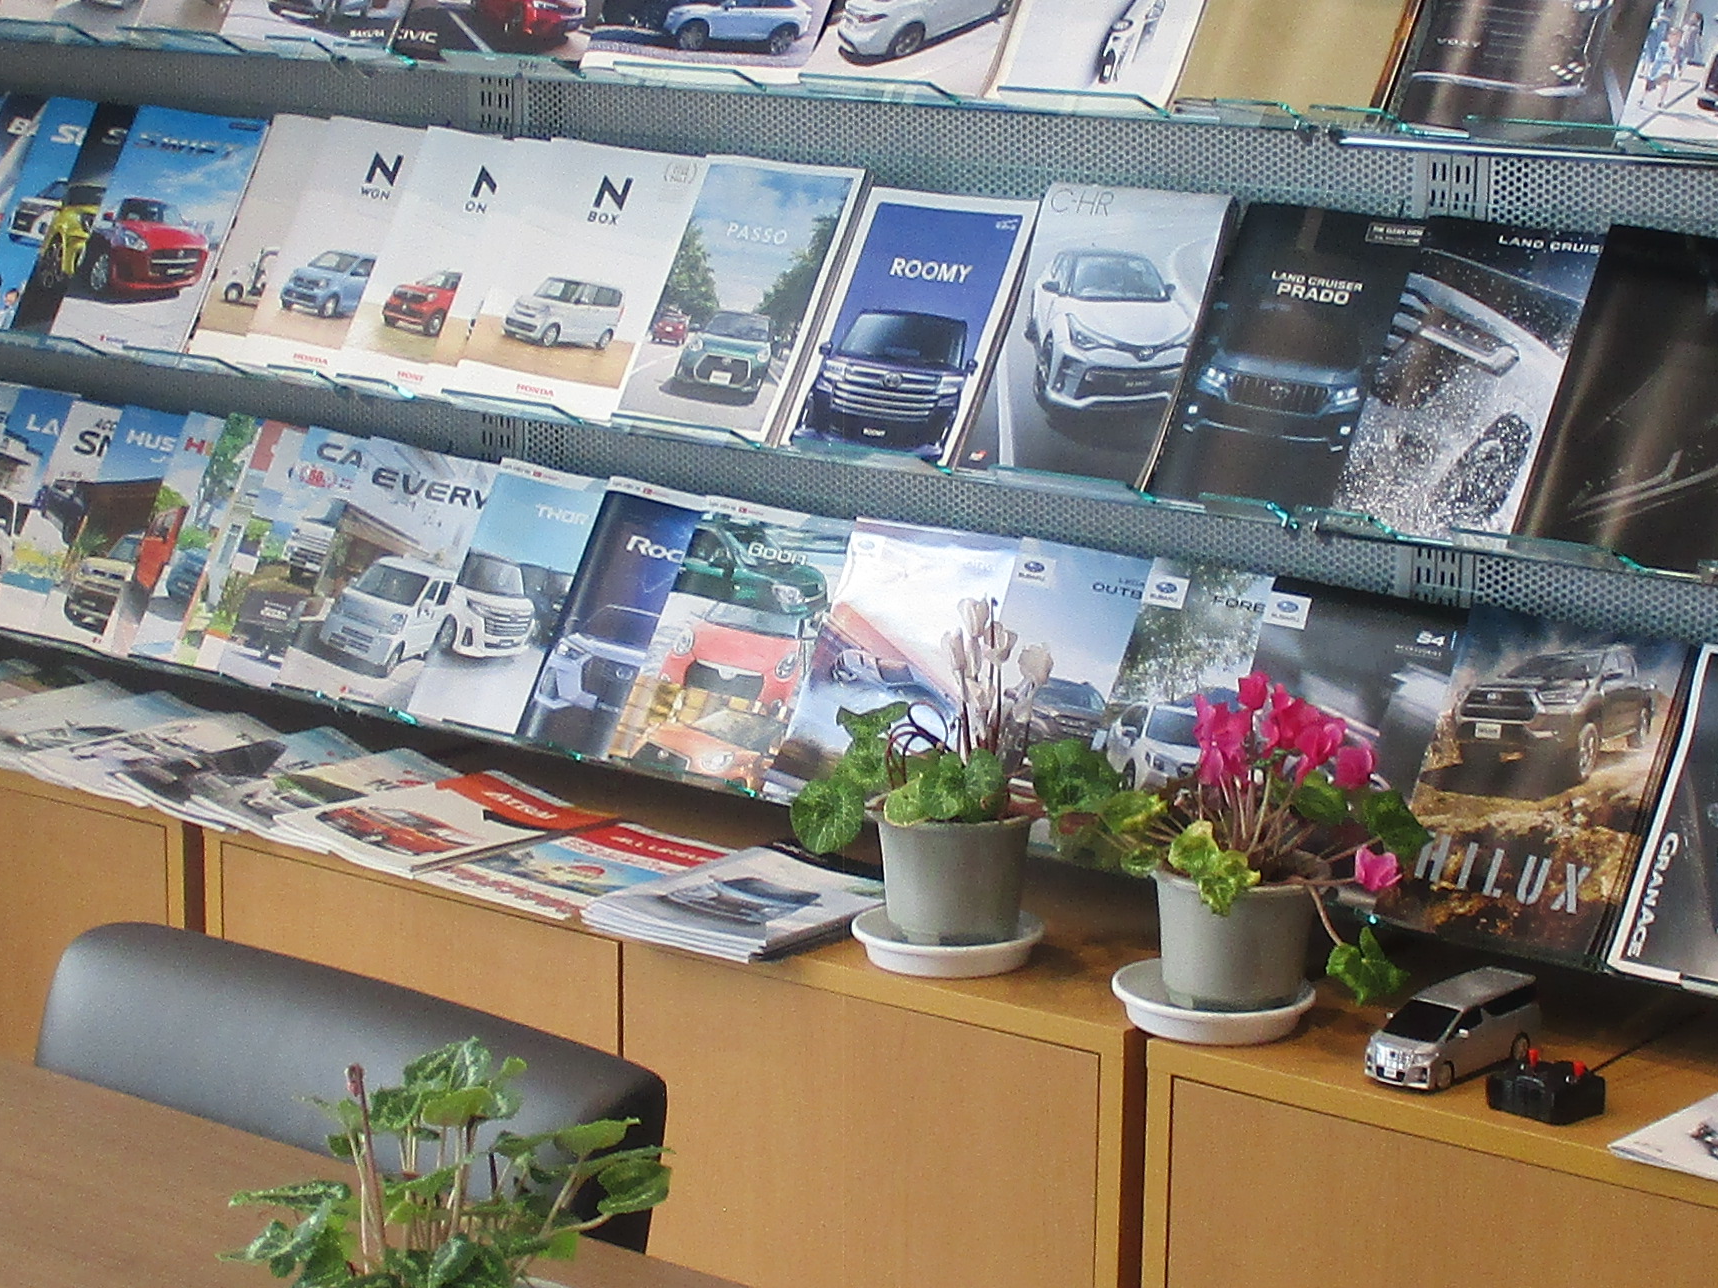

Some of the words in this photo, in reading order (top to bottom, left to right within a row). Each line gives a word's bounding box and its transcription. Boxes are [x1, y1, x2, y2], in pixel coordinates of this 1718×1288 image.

[366, 151, 404, 188] N
[361, 186, 391, 201] WGN
[592, 174, 633, 211] N
[1049, 189, 1115, 217] C-HR
[586, 211, 621, 226] BOX
[726, 221, 788, 245] PASSO
[1497, 234, 1544, 250] LAND
[888, 257, 974, 285] ROOMY
[1271, 270, 1305, 286] LAND
[1307, 276, 1362, 292] CRUISER
[1276, 282, 1351, 307] PRADO
[294, 352, 328, 365] HONDA
[516, 382, 554, 396] HONDA
[747, 541, 809, 566] Boon
[1211, 593, 1264, 613] FORE
[1412, 831, 1592, 915] HILUX
[1626, 831, 1680, 958] GRANACE
